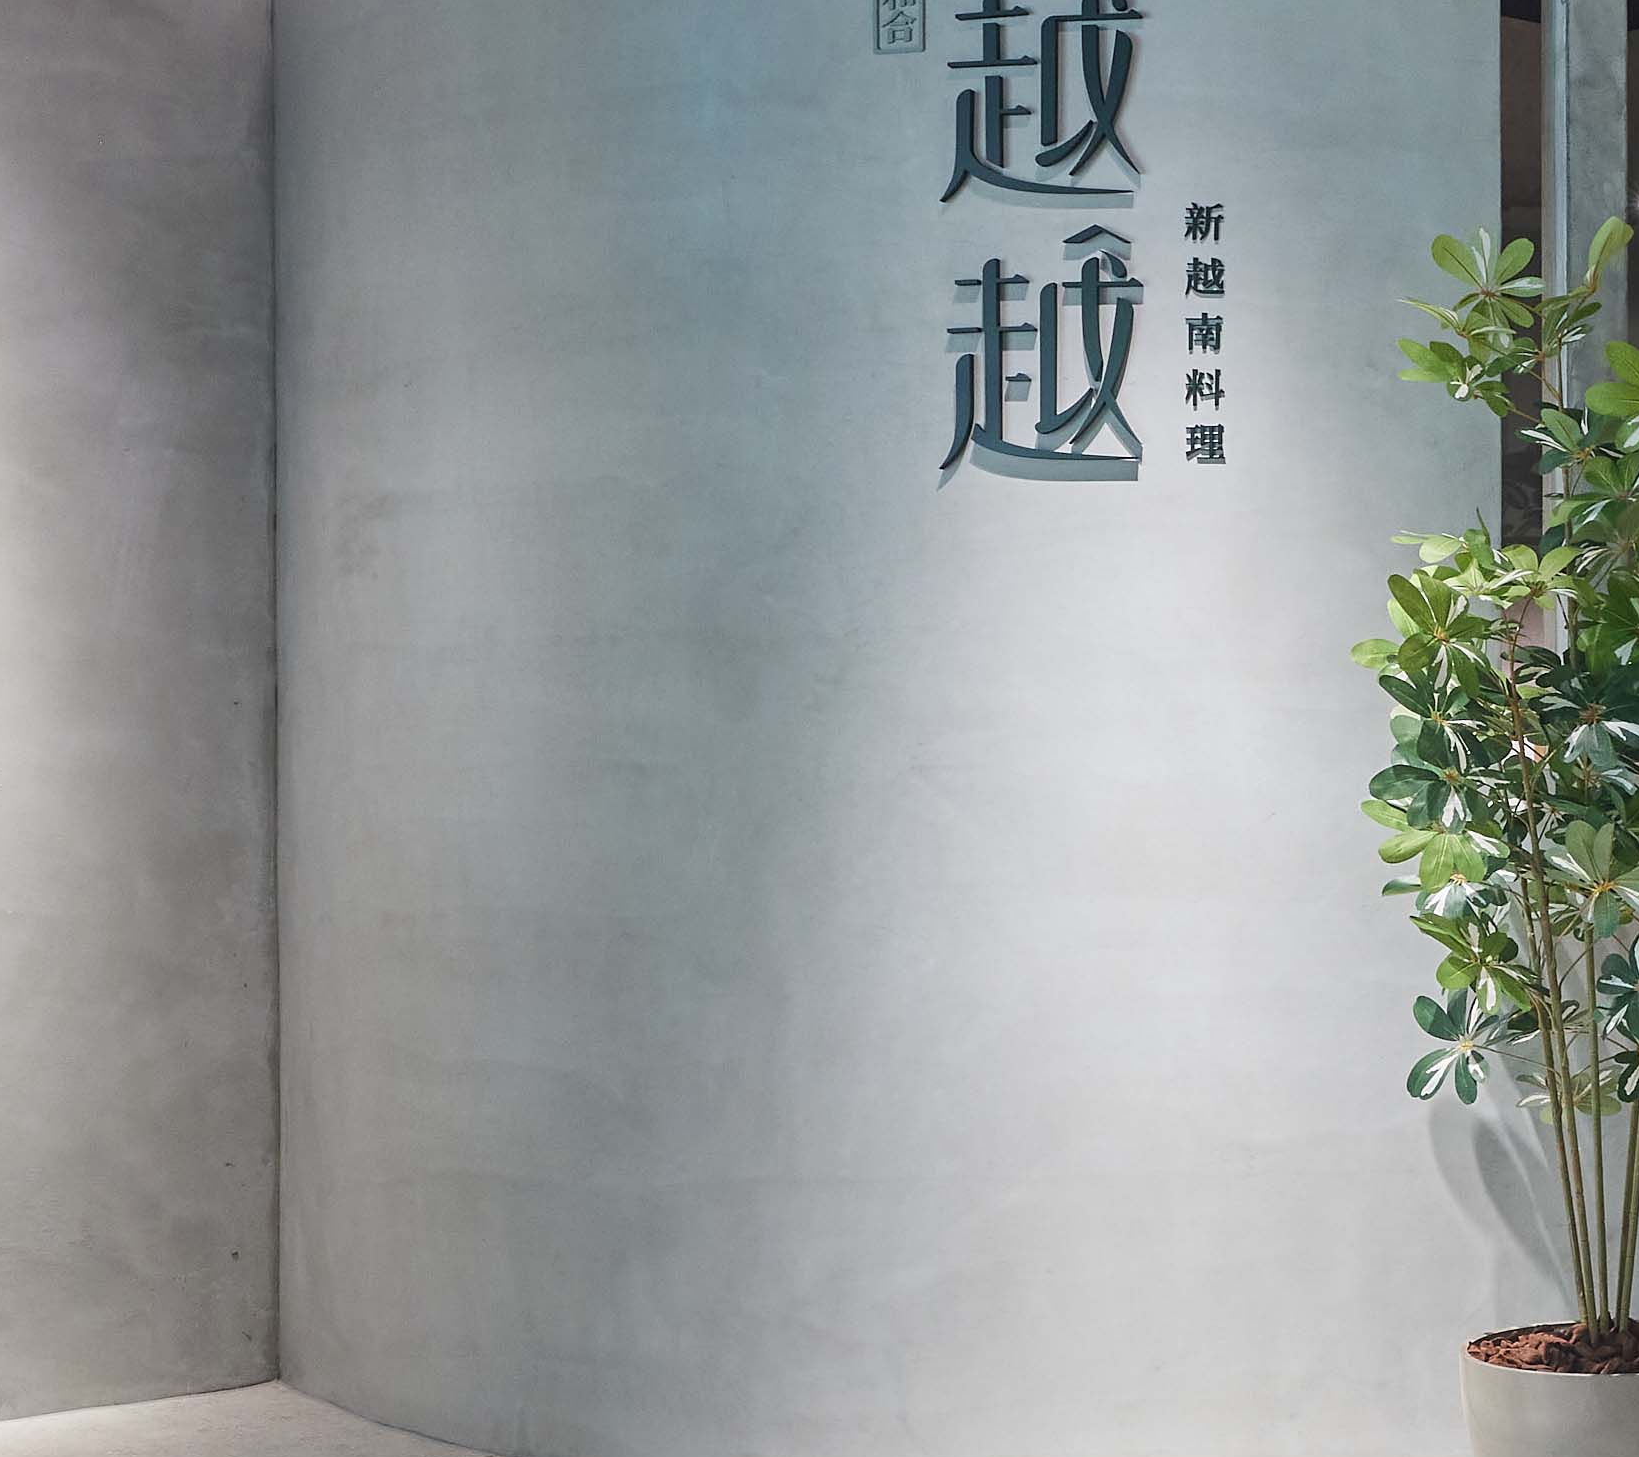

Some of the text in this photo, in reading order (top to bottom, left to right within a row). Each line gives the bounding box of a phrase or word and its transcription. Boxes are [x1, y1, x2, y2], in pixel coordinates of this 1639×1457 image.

[1183, 201, 1226, 464] 新越南料理
